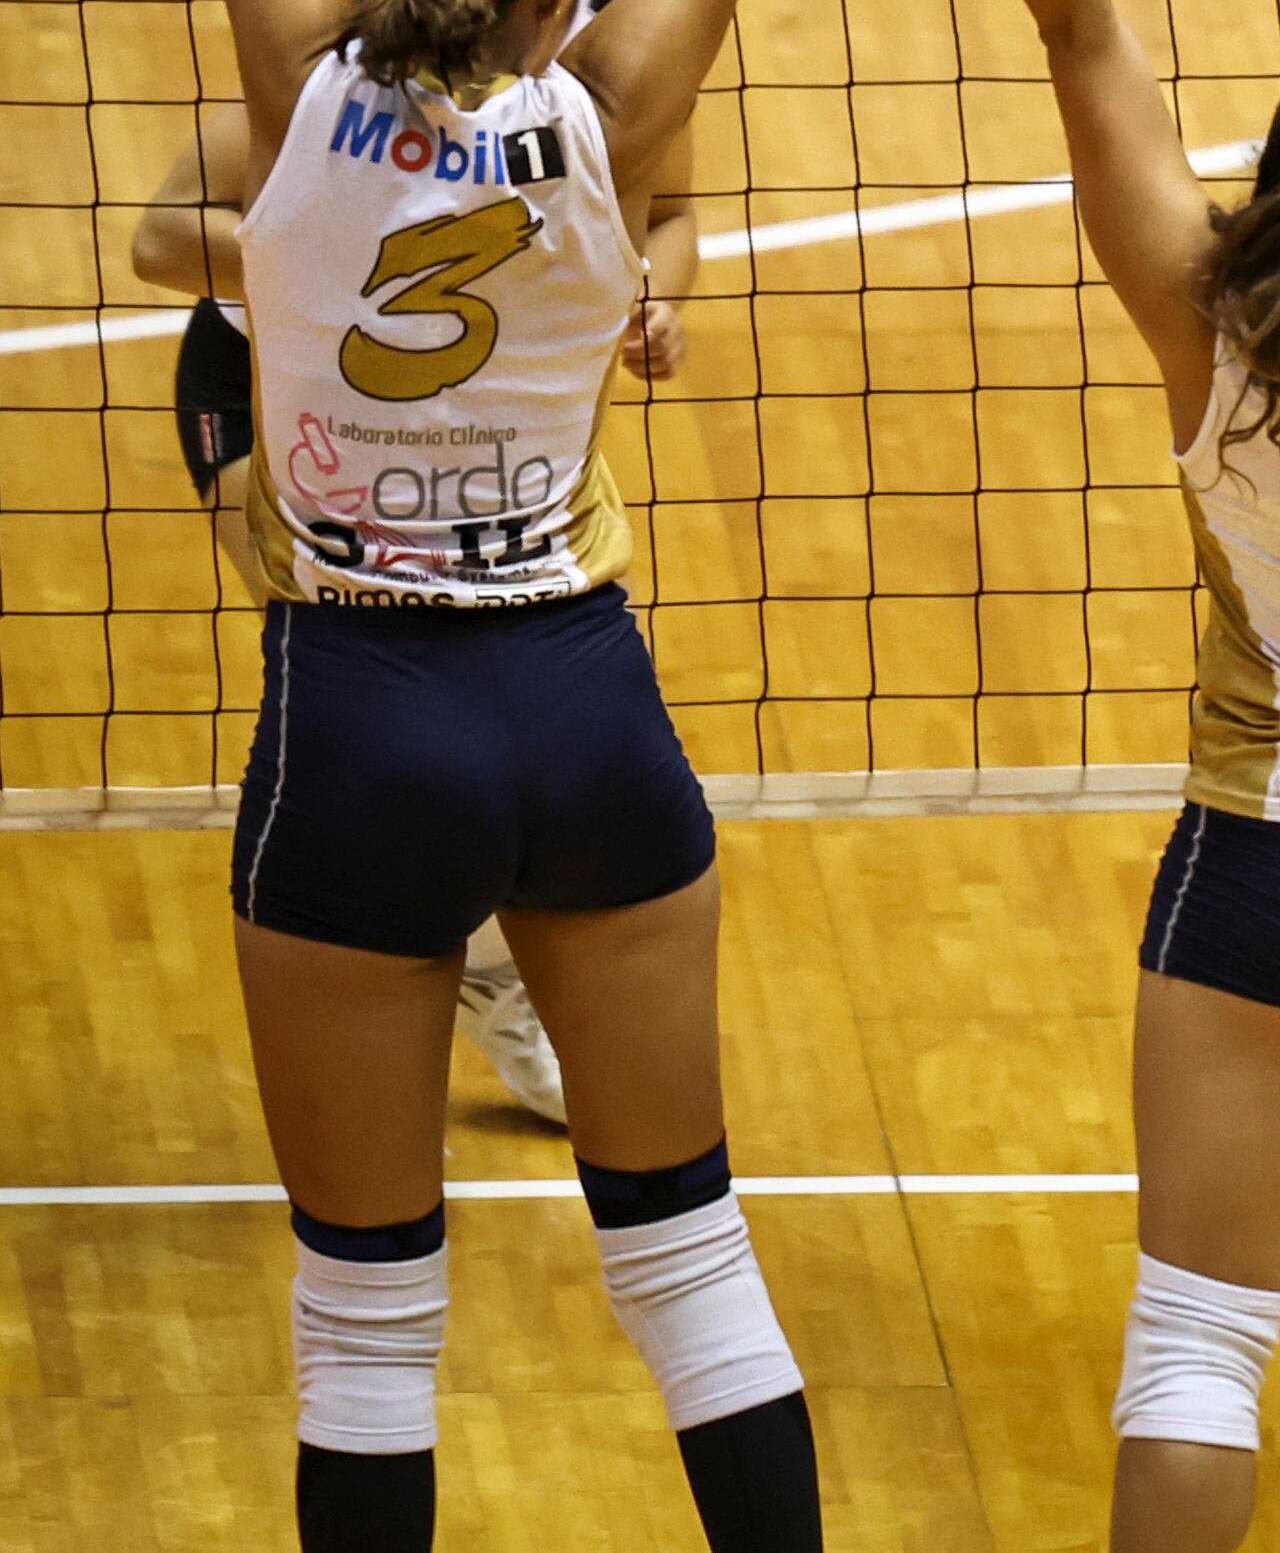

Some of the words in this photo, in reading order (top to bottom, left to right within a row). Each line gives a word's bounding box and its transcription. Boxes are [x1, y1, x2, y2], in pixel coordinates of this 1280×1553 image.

[330, 100, 505, 186] Mobil
[338, 195, 544, 403] 3
[327, 415, 443, 446] Laboratorio
